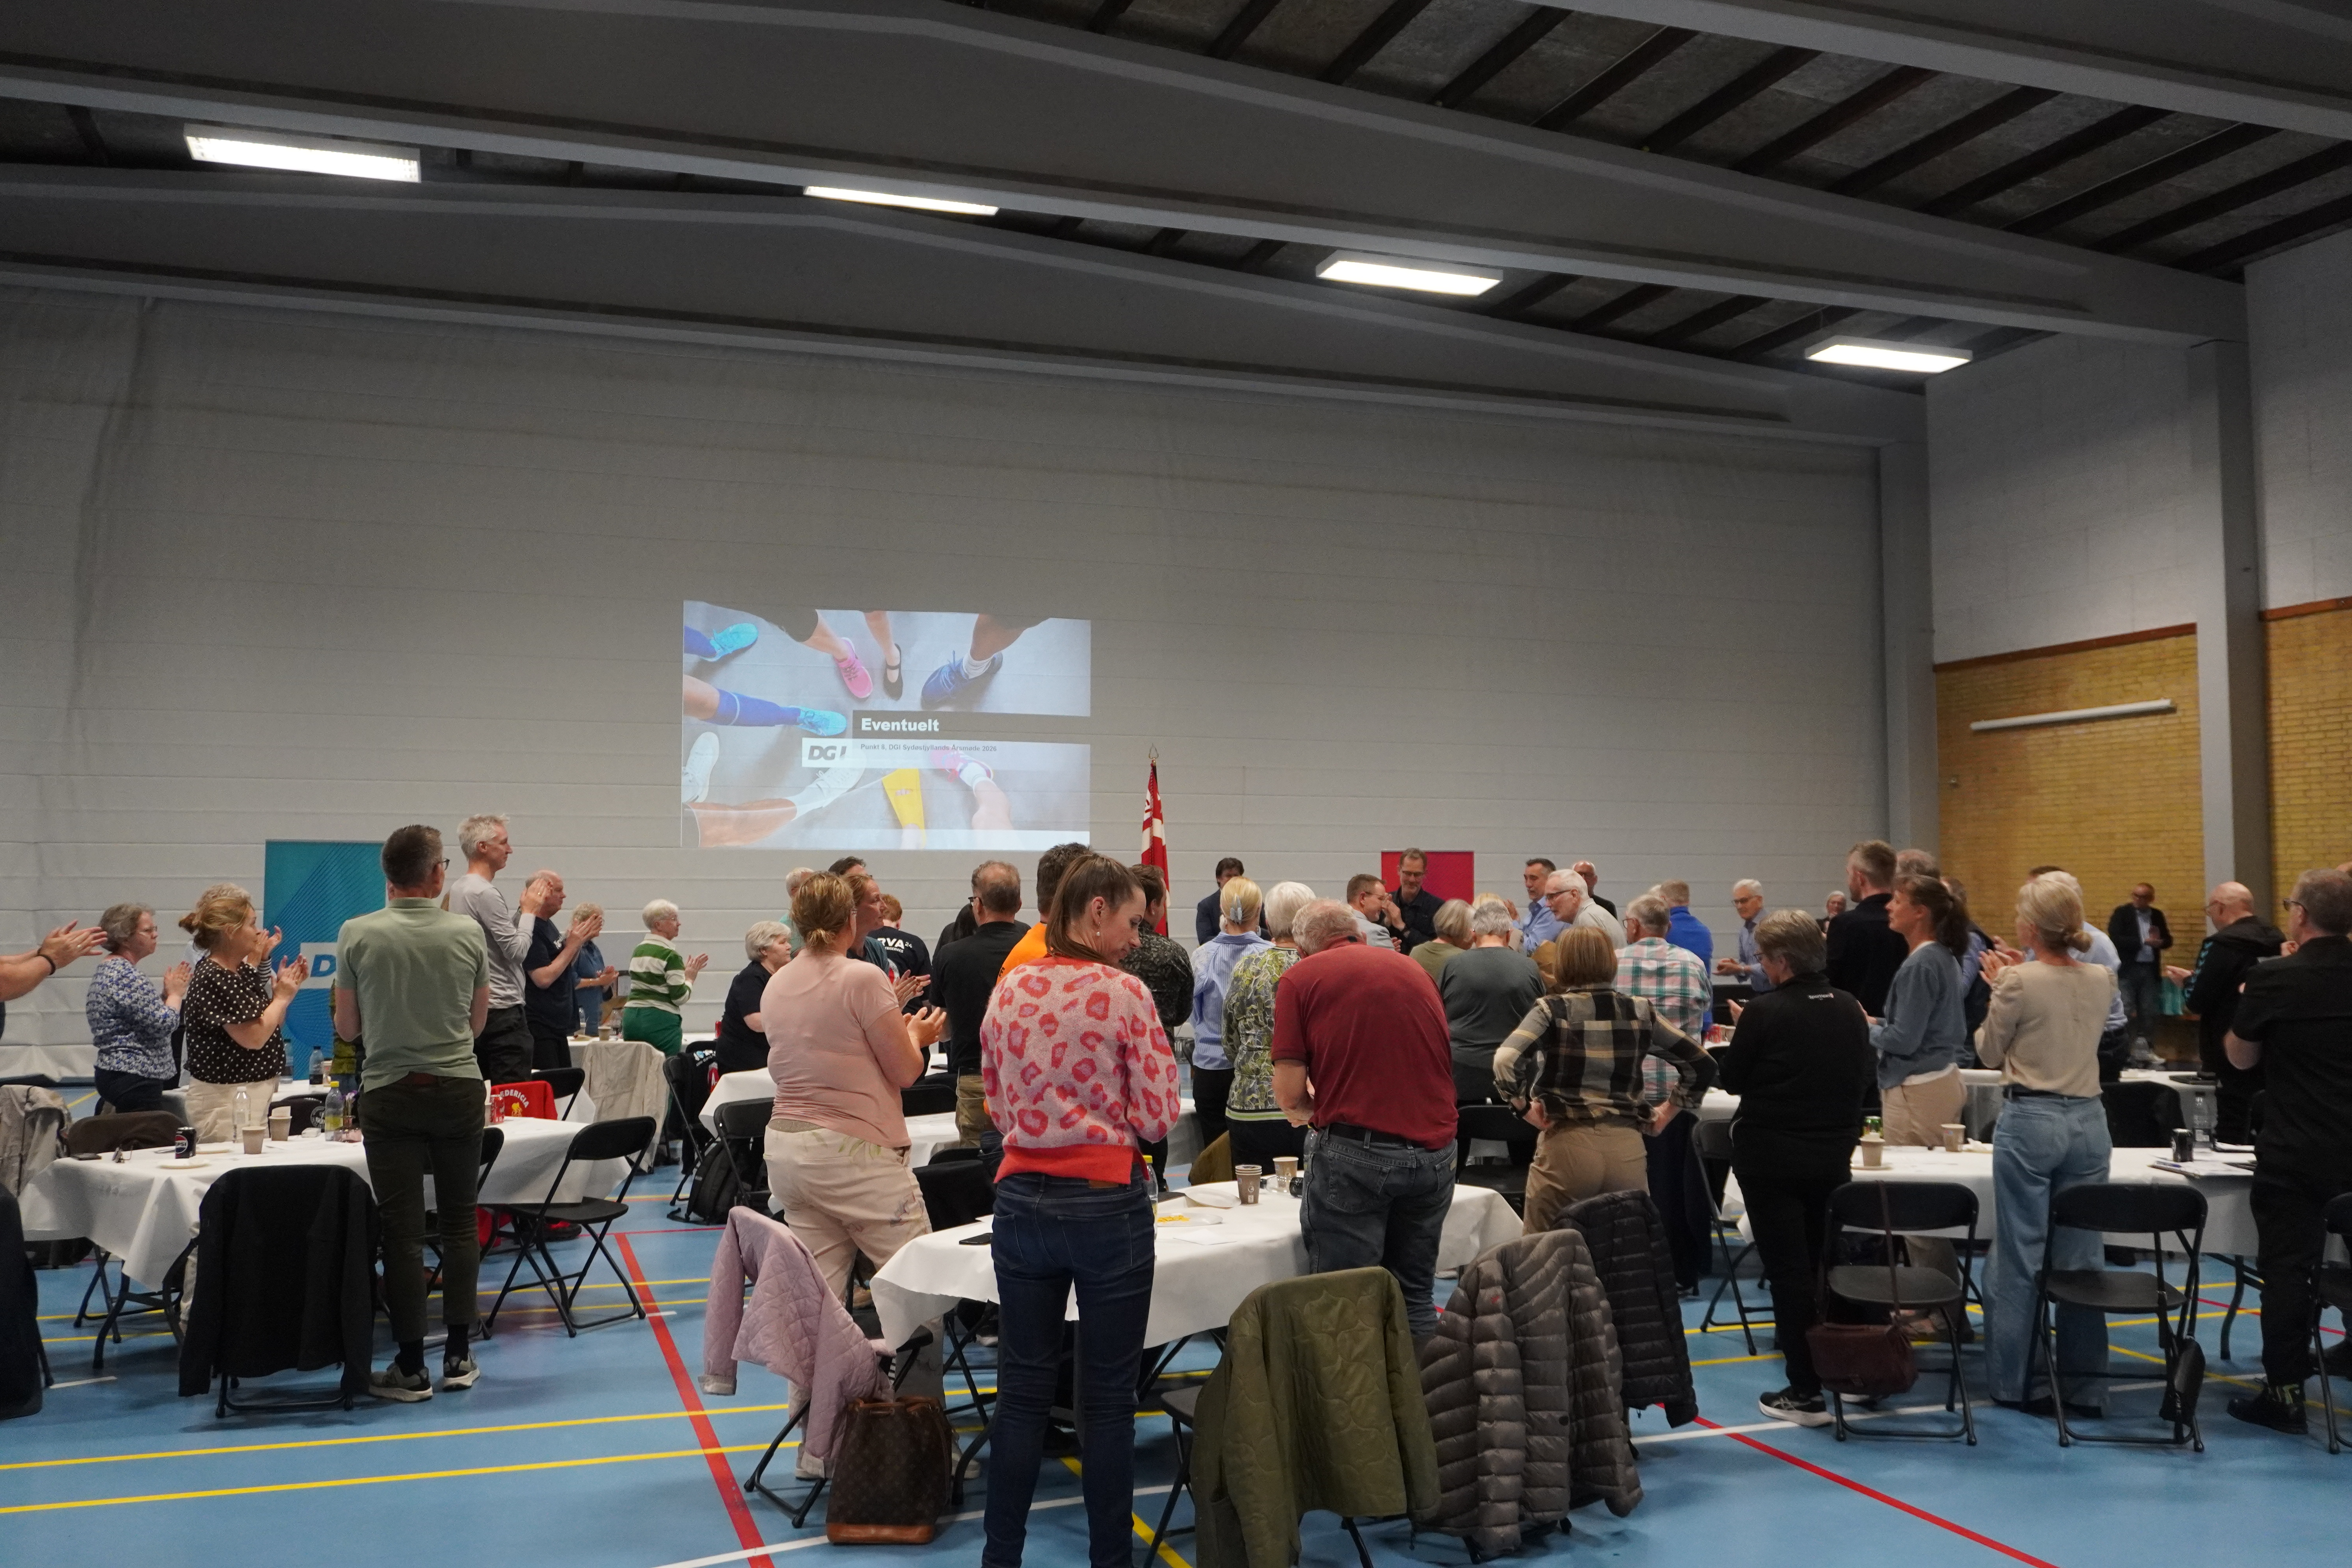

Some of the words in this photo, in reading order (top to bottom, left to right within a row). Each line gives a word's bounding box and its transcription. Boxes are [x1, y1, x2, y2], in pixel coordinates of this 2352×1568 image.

[862, 718, 939, 731] Eventuelt
[808, 746, 847, 760] DGI
[500, 1089, 529, 1109] EDERICIA
